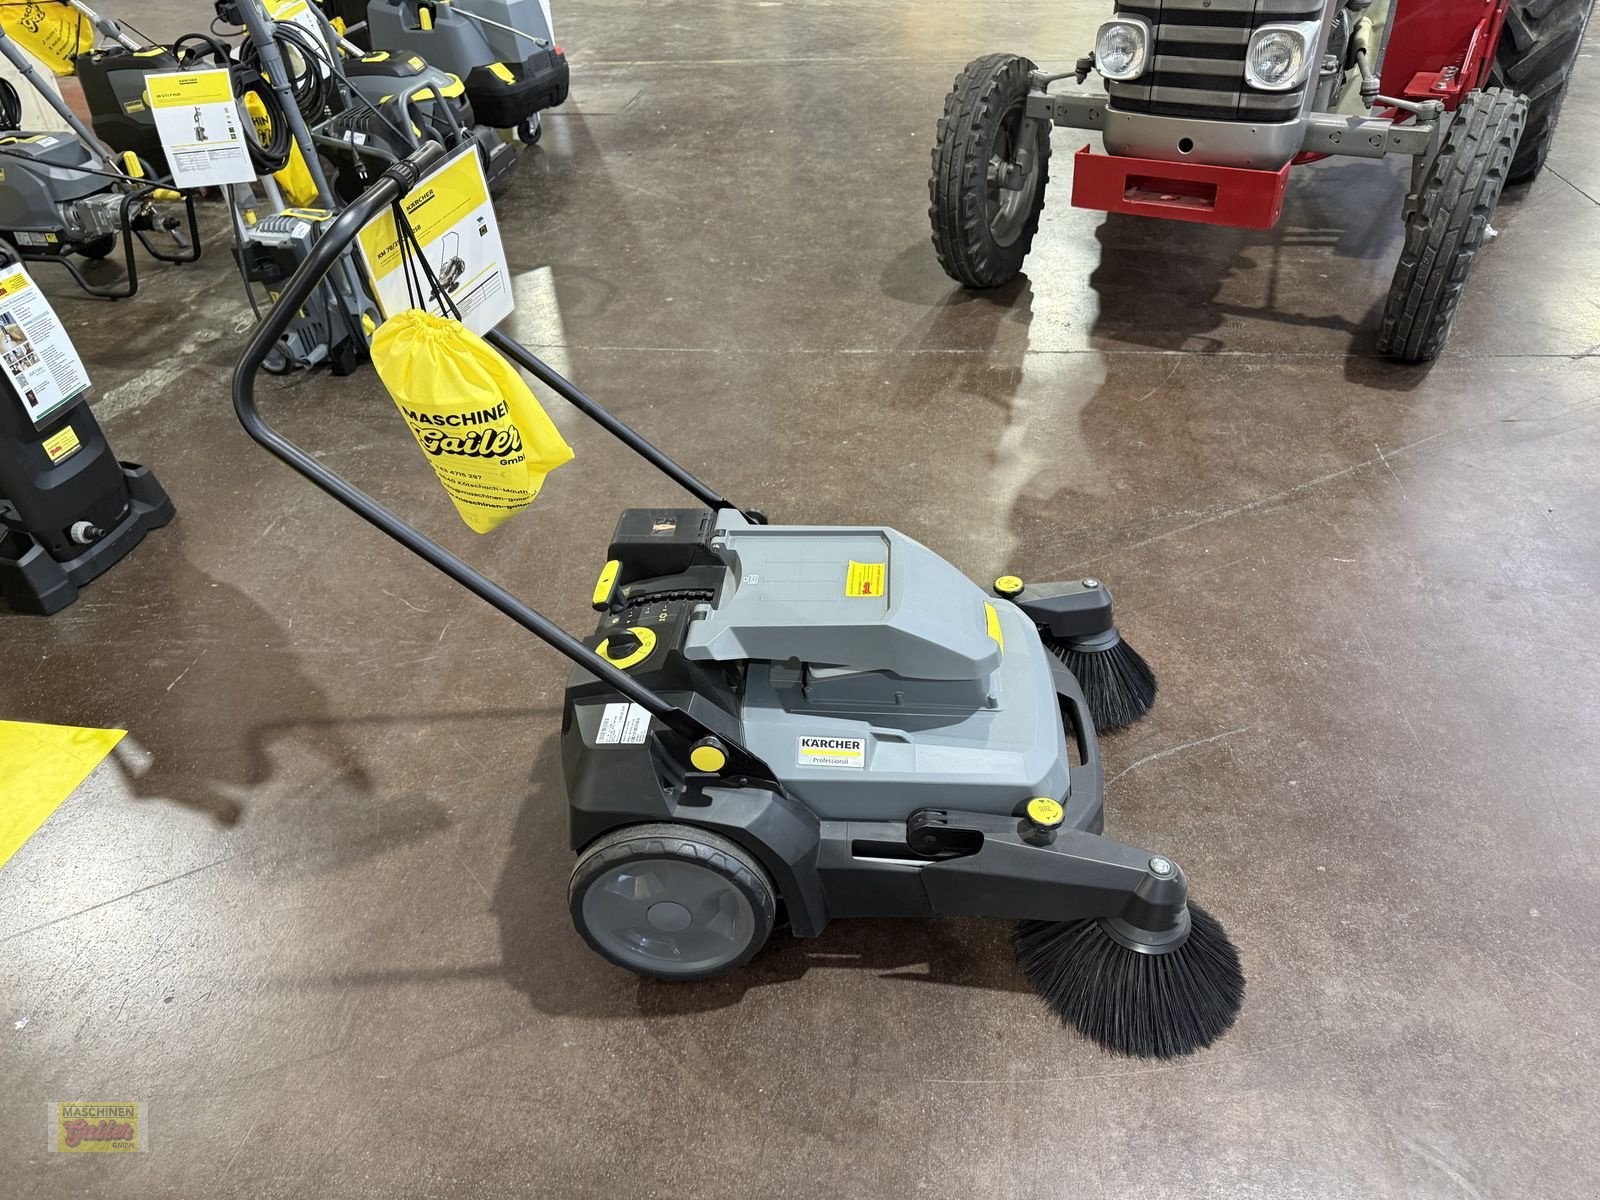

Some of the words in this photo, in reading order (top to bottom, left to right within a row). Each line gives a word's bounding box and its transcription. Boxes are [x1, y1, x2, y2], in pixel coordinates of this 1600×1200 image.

[410, 424, 522, 458] Gailer
[802, 738, 860, 750] KÄRCHER
[813, 757, 849, 765] Professional
